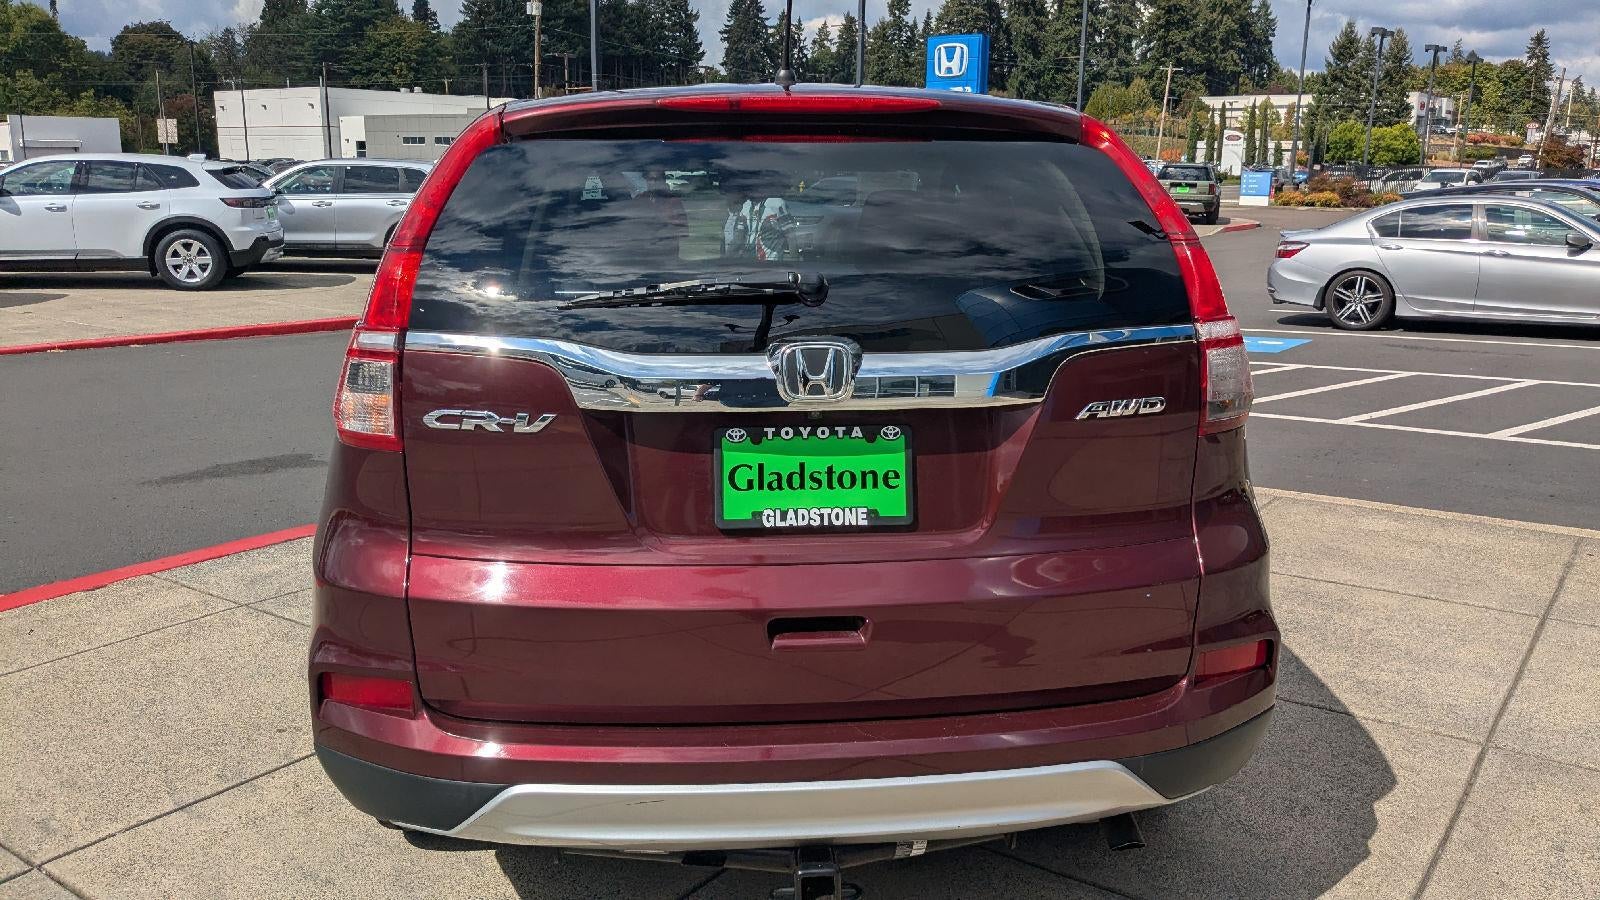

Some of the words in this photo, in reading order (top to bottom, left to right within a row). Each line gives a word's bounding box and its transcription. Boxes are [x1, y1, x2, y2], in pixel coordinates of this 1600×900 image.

[1074, 396, 1166, 420] AWD
[423, 409, 557, 433] CR-V
[764, 426, 863, 440] TOYOTA
[728, 462, 900, 491] Gladstone
[762, 507, 868, 527] GLADSTONE
